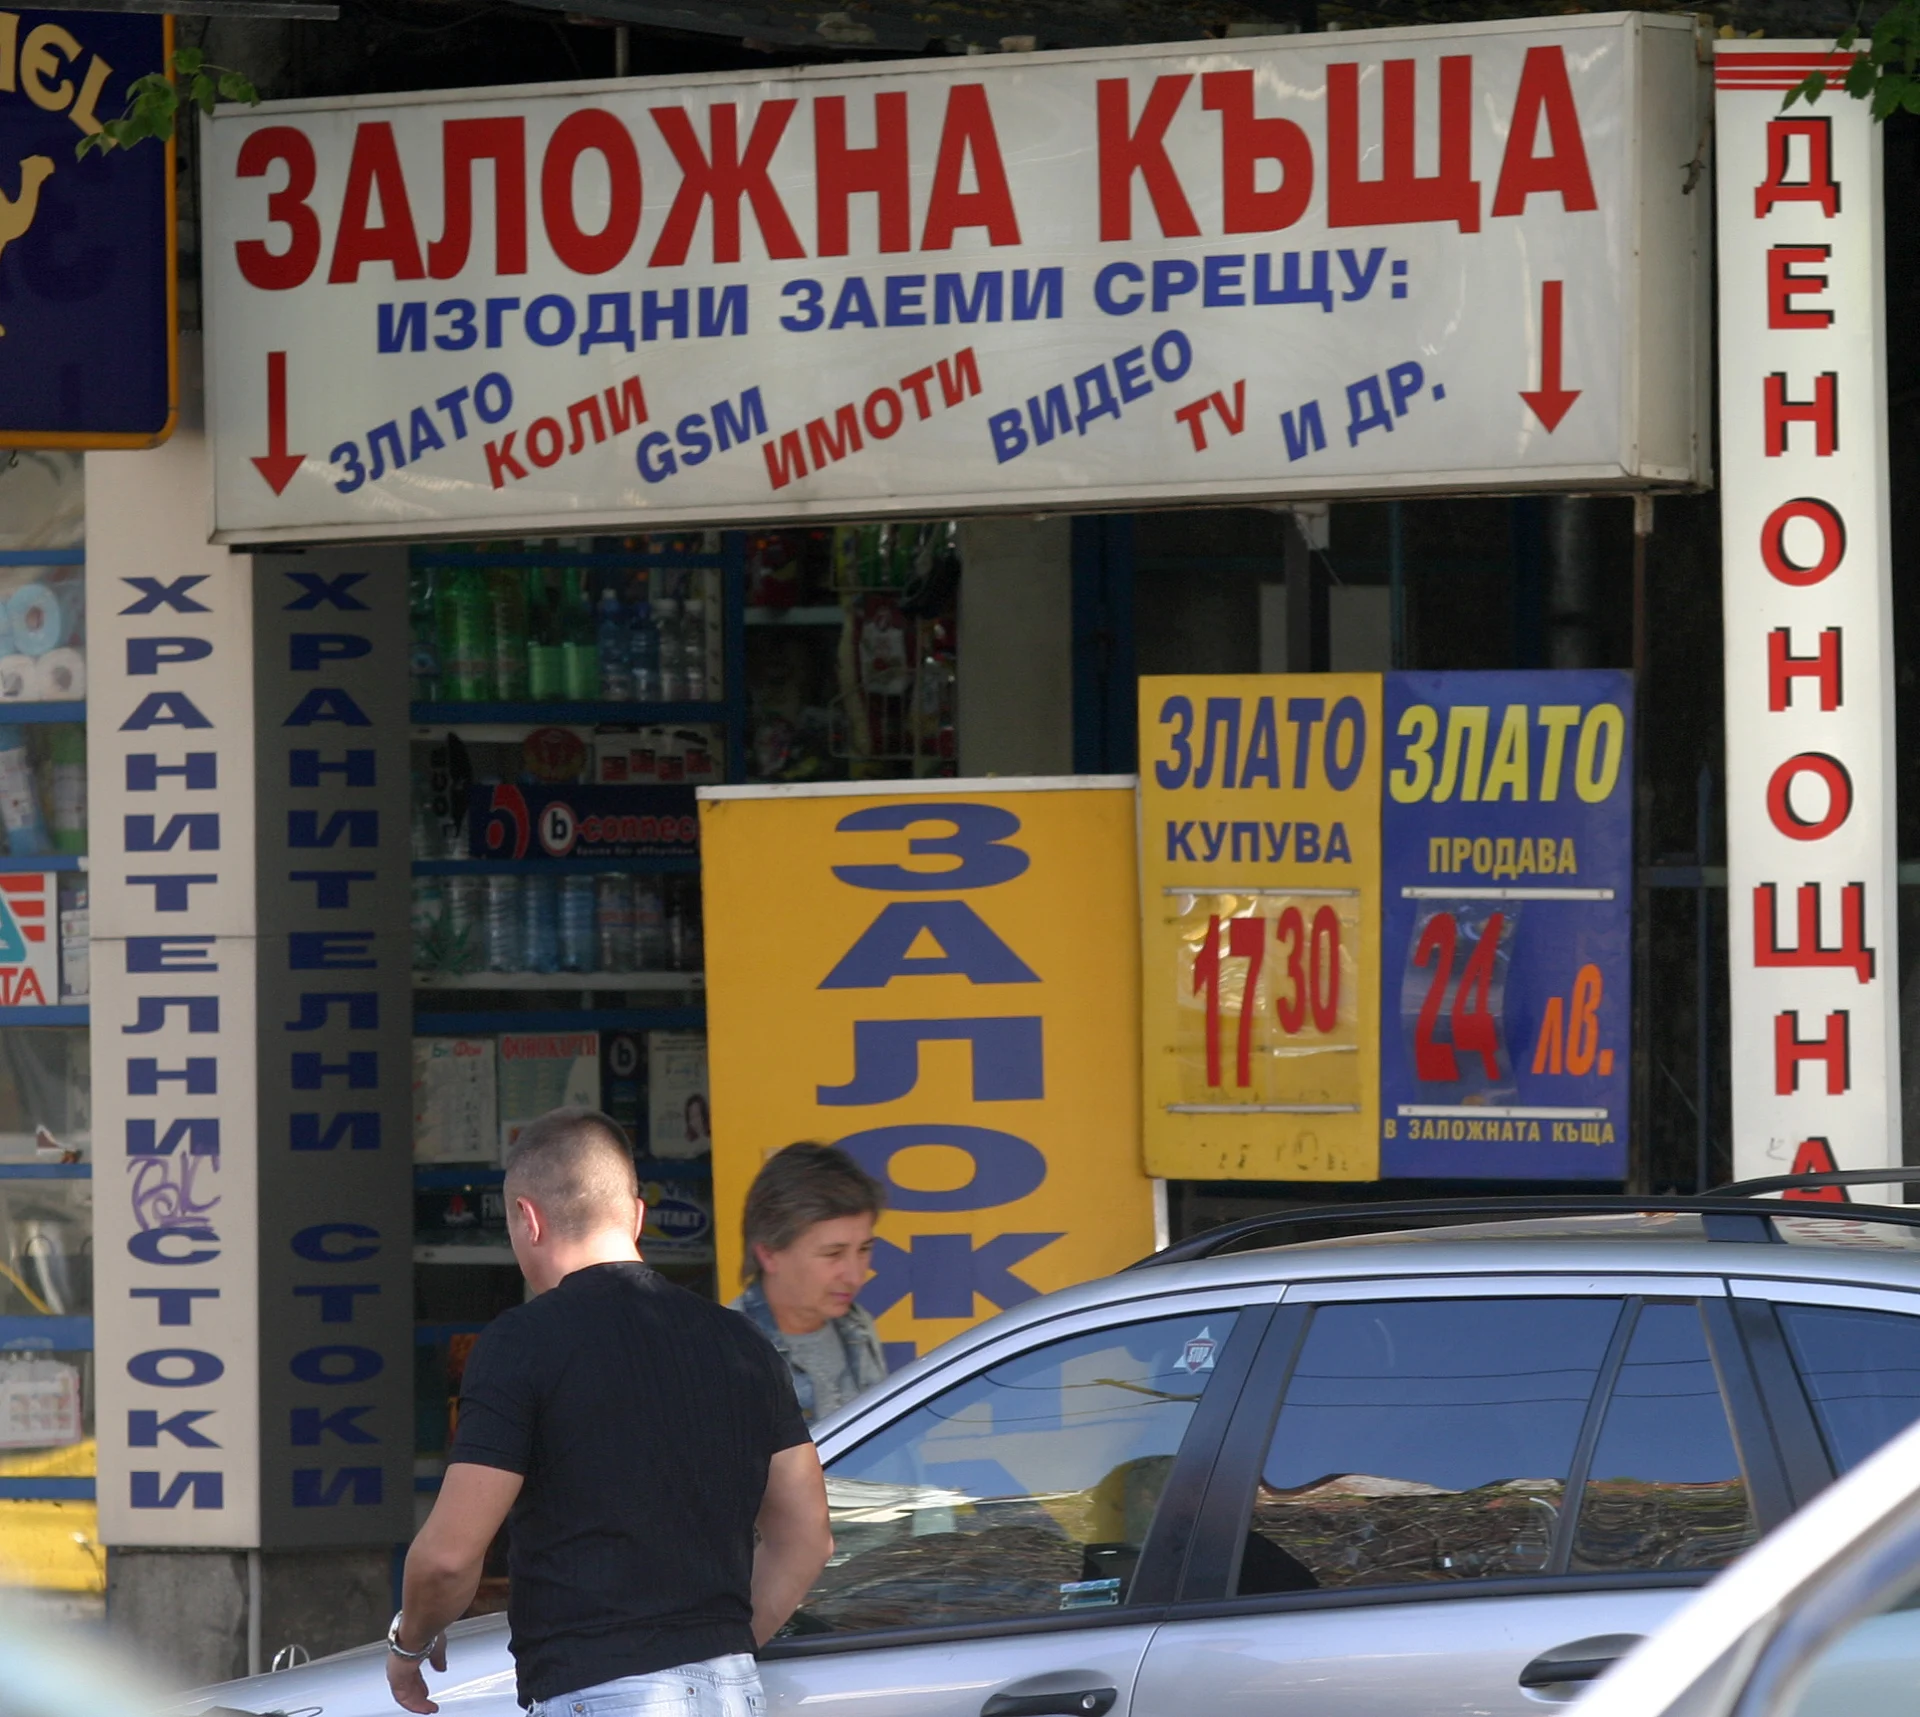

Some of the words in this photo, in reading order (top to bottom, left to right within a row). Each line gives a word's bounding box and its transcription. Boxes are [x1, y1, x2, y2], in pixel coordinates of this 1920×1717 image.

[235, 83, 1022, 291] ЗАЛОЖНА
[1096, 45, 1598, 242] КЪЩА
[377, 284, 748, 354] ИЗГОДНИ
[779, 266, 1064, 332] ЗАЕМИ
[1094, 247, 1408, 316] СРЕЩУ:
[329, 372, 514, 494] ЗЛАТО
[484, 375, 649, 490] КОЛИ
[635, 386, 768, 484] GSM
[762, 346, 982, 490] ИМОТИ
[987, 329, 1193, 464] ВИДЕО
[1174, 378, 1246, 453] TV
[1279, 400, 1327, 462] И
[1344, 360, 1446, 447] ДР.
[1155, 695, 1367, 791] ЗЛАТО
[1753, 116, 1876, 1203] ДЕНОНОЩНА
[1389, 703, 1624, 804] ЗЛАТО
[117, 574, 220, 1156] ХРАНИТЕЛНИ
[280, 572, 382, 1151] ХРАНИТЕЛНИ
[1166, 821, 1352, 863] КУПУВА
[1429, 837, 1577, 880] ПРОДАВА
[0, 967, 46, 1005] TA
[1193, 914, 1265, 1088] 17
[1276, 904, 1340, 1034] 30
[1413, 912, 1504, 1081] 24
[816, 802, 1068, 1373] ЗАЛОЖ
[1385, 1119, 1396, 1140] В
[1409, 1119, 1540, 1143] ЗАЛОЖНАТА
[1553, 1121, 1614, 1146] КЪЩА
[126, 1226, 225, 1510] СТОКИ
[290, 1223, 384, 1508] СТОКИ
